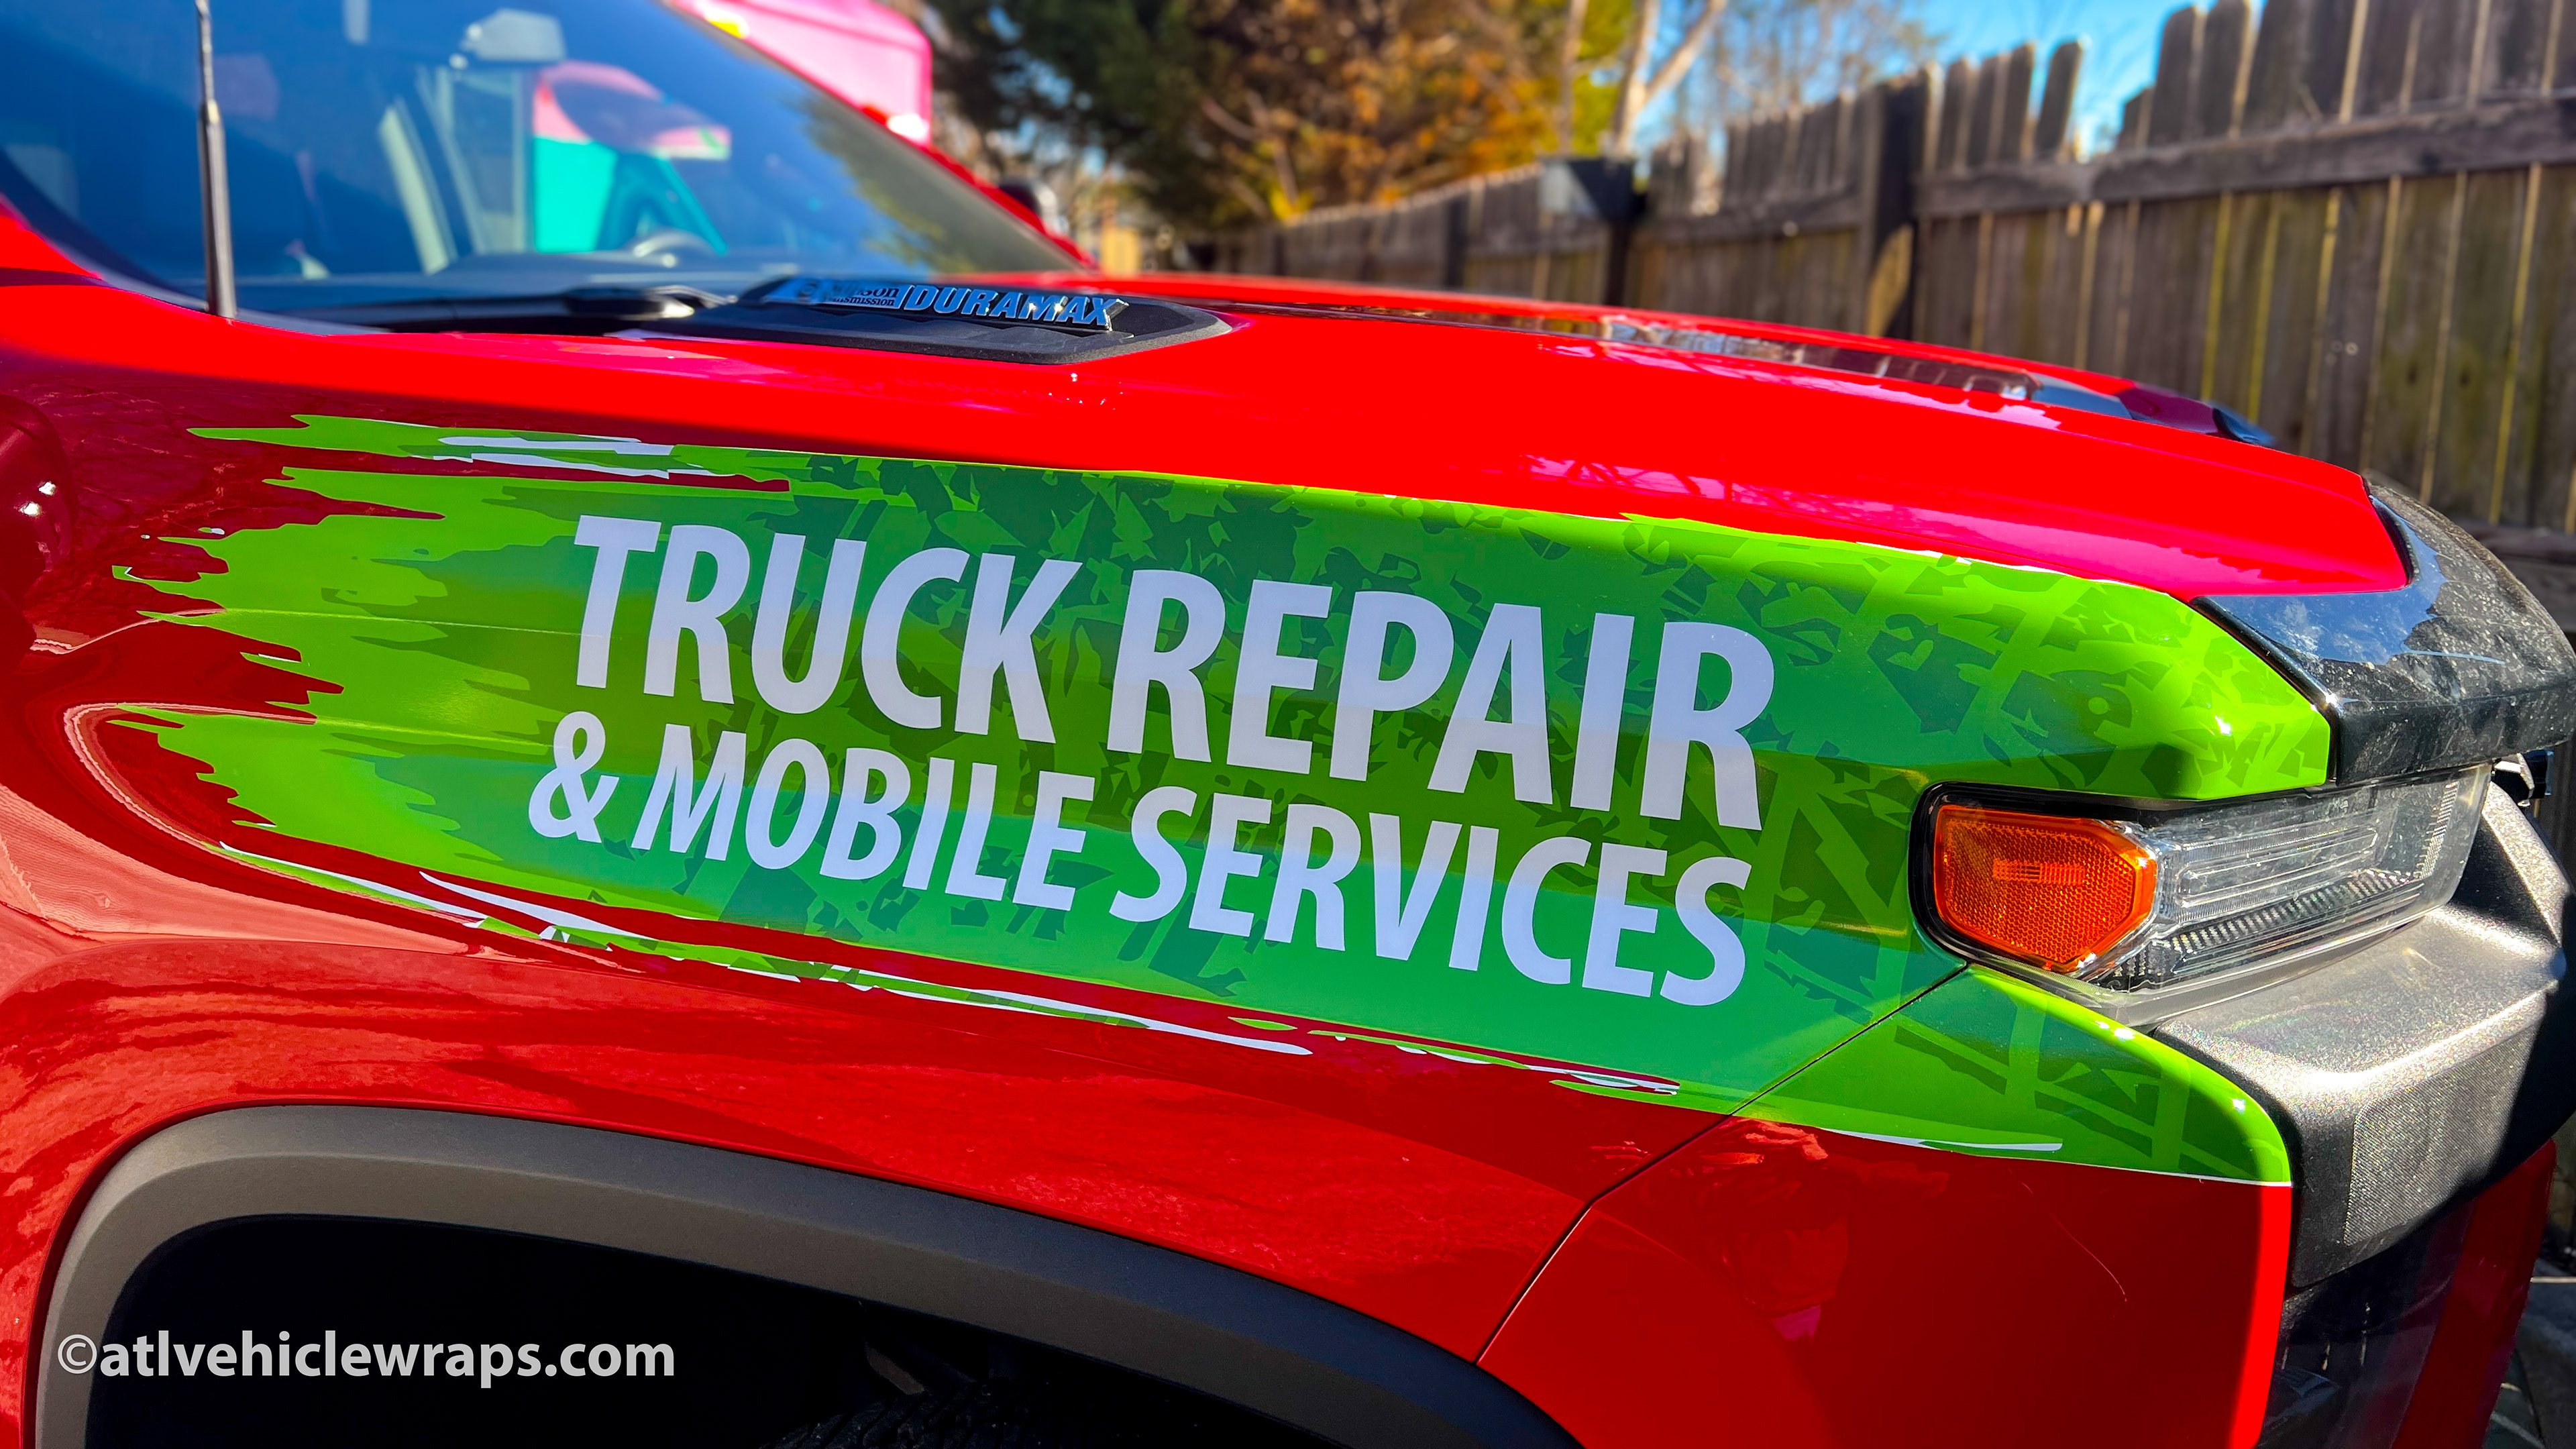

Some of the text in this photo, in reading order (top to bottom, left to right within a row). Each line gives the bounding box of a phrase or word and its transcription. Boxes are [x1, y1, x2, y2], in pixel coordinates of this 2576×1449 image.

[904, 284, 1126, 327] DURAMAX
[574, 515, 1775, 830] TRUCK REPAIR
[528, 711, 1752, 1007] & MOBILE SERVICES
